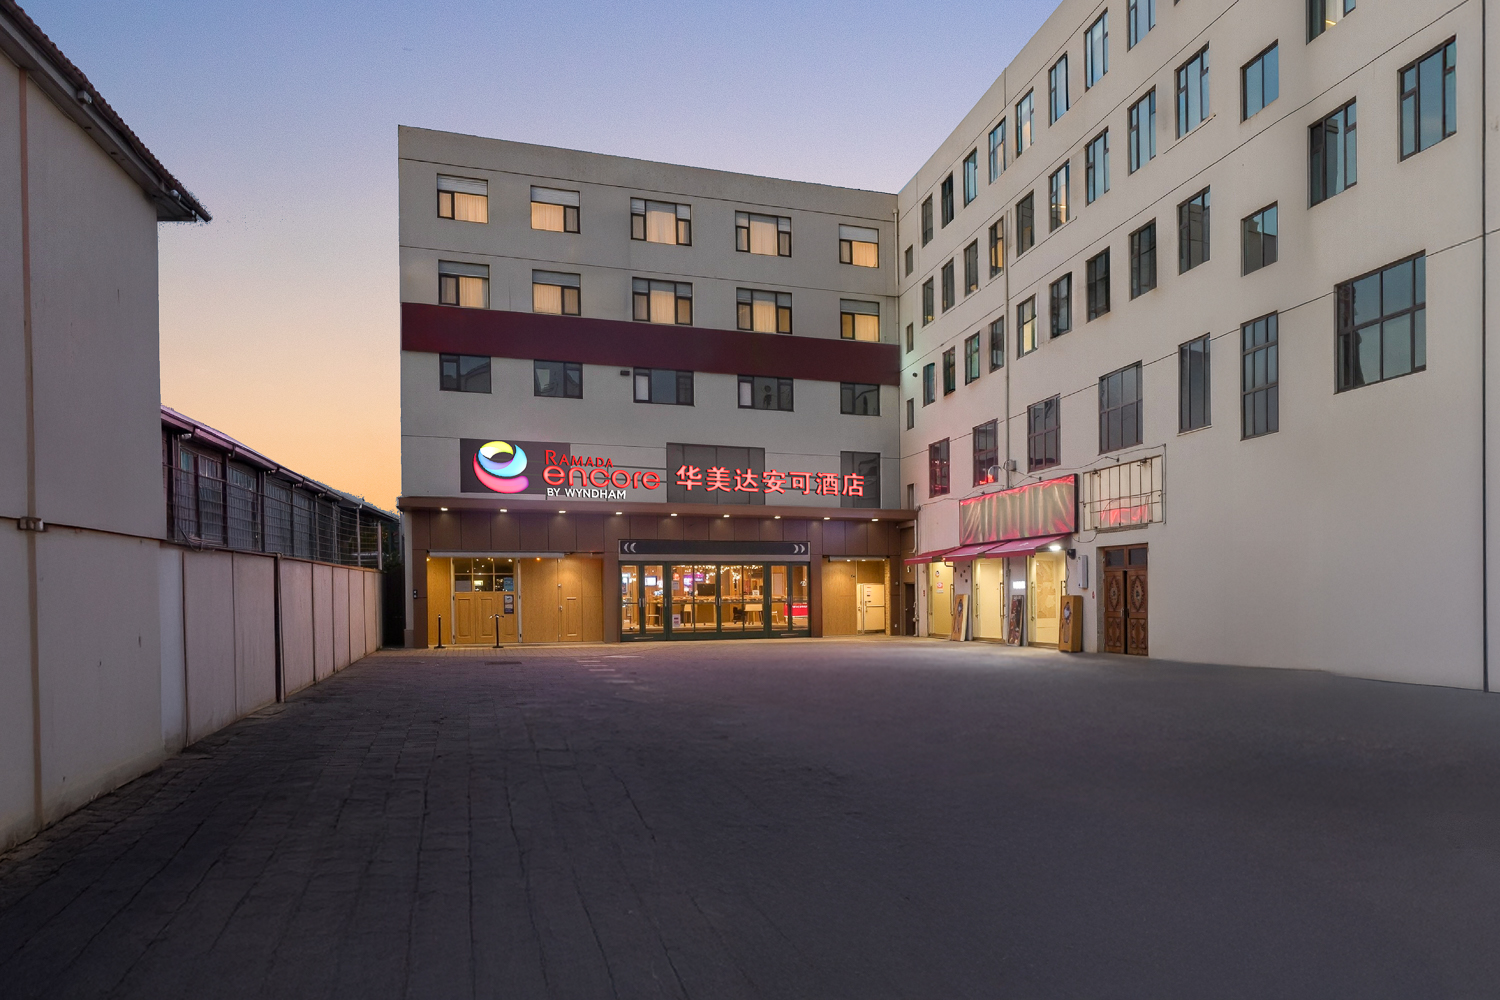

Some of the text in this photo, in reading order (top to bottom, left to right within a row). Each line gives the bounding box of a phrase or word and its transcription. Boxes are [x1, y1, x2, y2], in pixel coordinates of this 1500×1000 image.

[545, 449, 614, 468] RAMADA
[542, 465, 660, 490] encore
[675, 464, 865, 497] 华美达安可酒店
[546, 487, 627, 499] BY WYNDHAM
